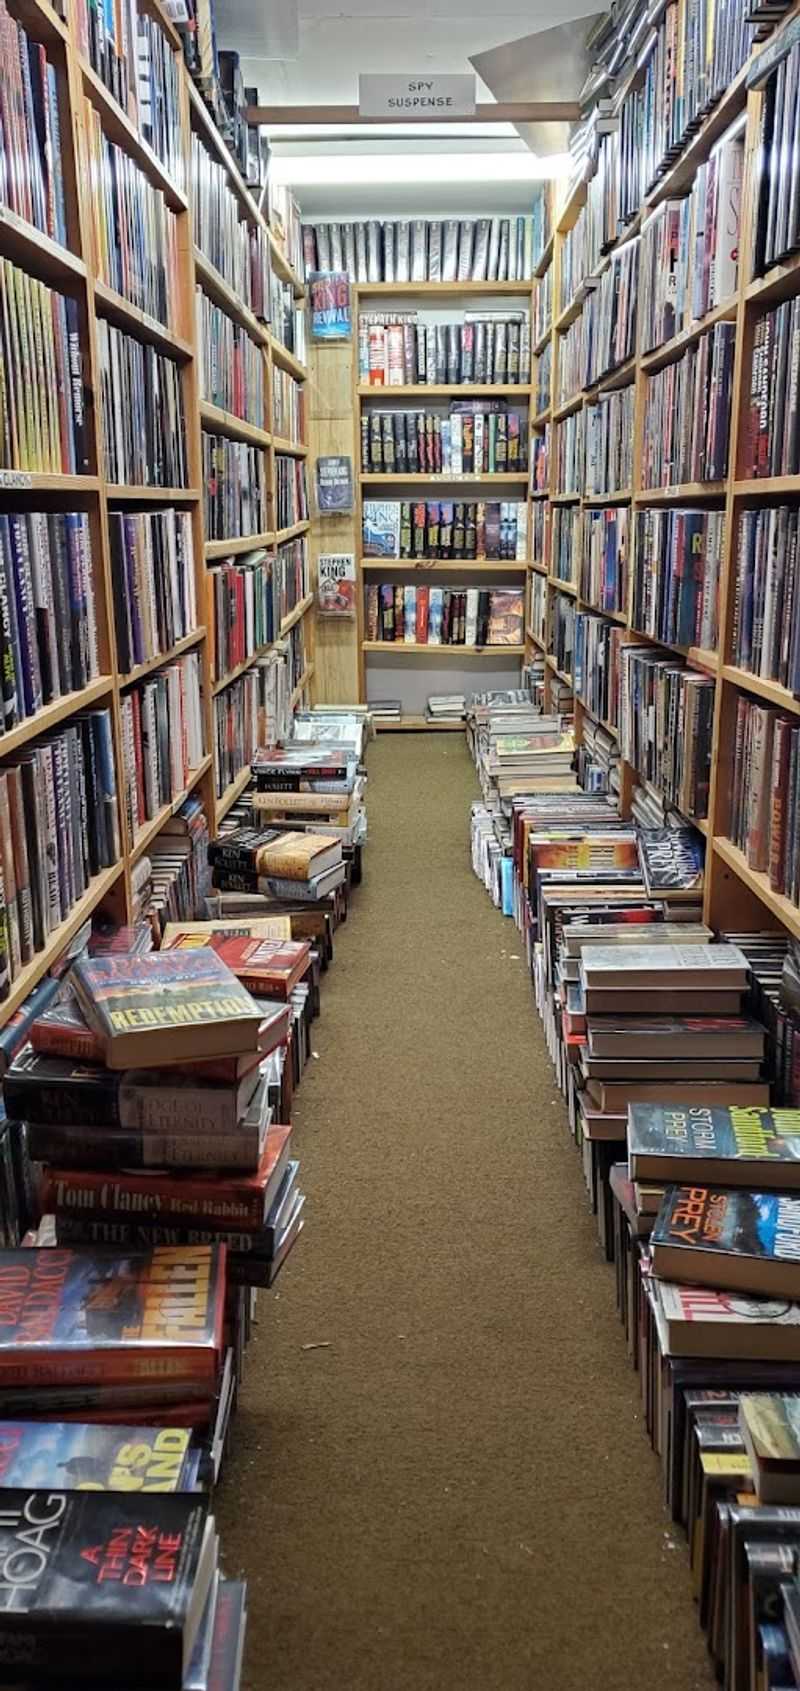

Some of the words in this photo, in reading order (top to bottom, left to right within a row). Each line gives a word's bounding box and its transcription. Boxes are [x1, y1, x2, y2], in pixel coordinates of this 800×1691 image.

[387, 96, 453, 108] SUSPENSE
[408, 81, 434, 92] SPY
[69, 332, 80, 375] Without
[73, 377, 84, 426] Remorse
[759, 357, 770, 429] SANDFORD
[319, 566, 346, 578] KING
[320, 558, 351, 566] STEPHEN
[772, 797, 783, 867] POWER
[646, 841, 676, 874] PREY
[110, 997, 258, 1030] REDEMPTION
[663, 1111, 689, 1143] PREY
[689, 1107, 717, 1150] STORM
[728, 1106, 781, 1158] Sandford
[54, 1180, 96, 1208] Tom
[100, 1183, 163, 1216] Clancy
[169, 1197, 198, 1212] Red
[202, 1199, 250, 1217] Rabbit
[669, 1187, 709, 1245] PREY
[700, 1194, 728, 1243] STOLEN
[89, 1223, 131, 1241] THE
[138, 1226, 182, 1244] NEW
[187, 1230, 252, 1252] BREED
[0, 1264, 32, 1326] DAVID
[15, 1250, 73, 1342] BALDACCI
[140, 1246, 212, 1342] FALLEN
[141, 1428, 191, 1491] AND
[0, 1494, 66, 1613] HOAG
[80, 1545, 100, 1565] A
[97, 1528, 133, 1584] THIN
[123, 1526, 158, 1586] DARK
[153, 1529, 183, 1582] LINE
